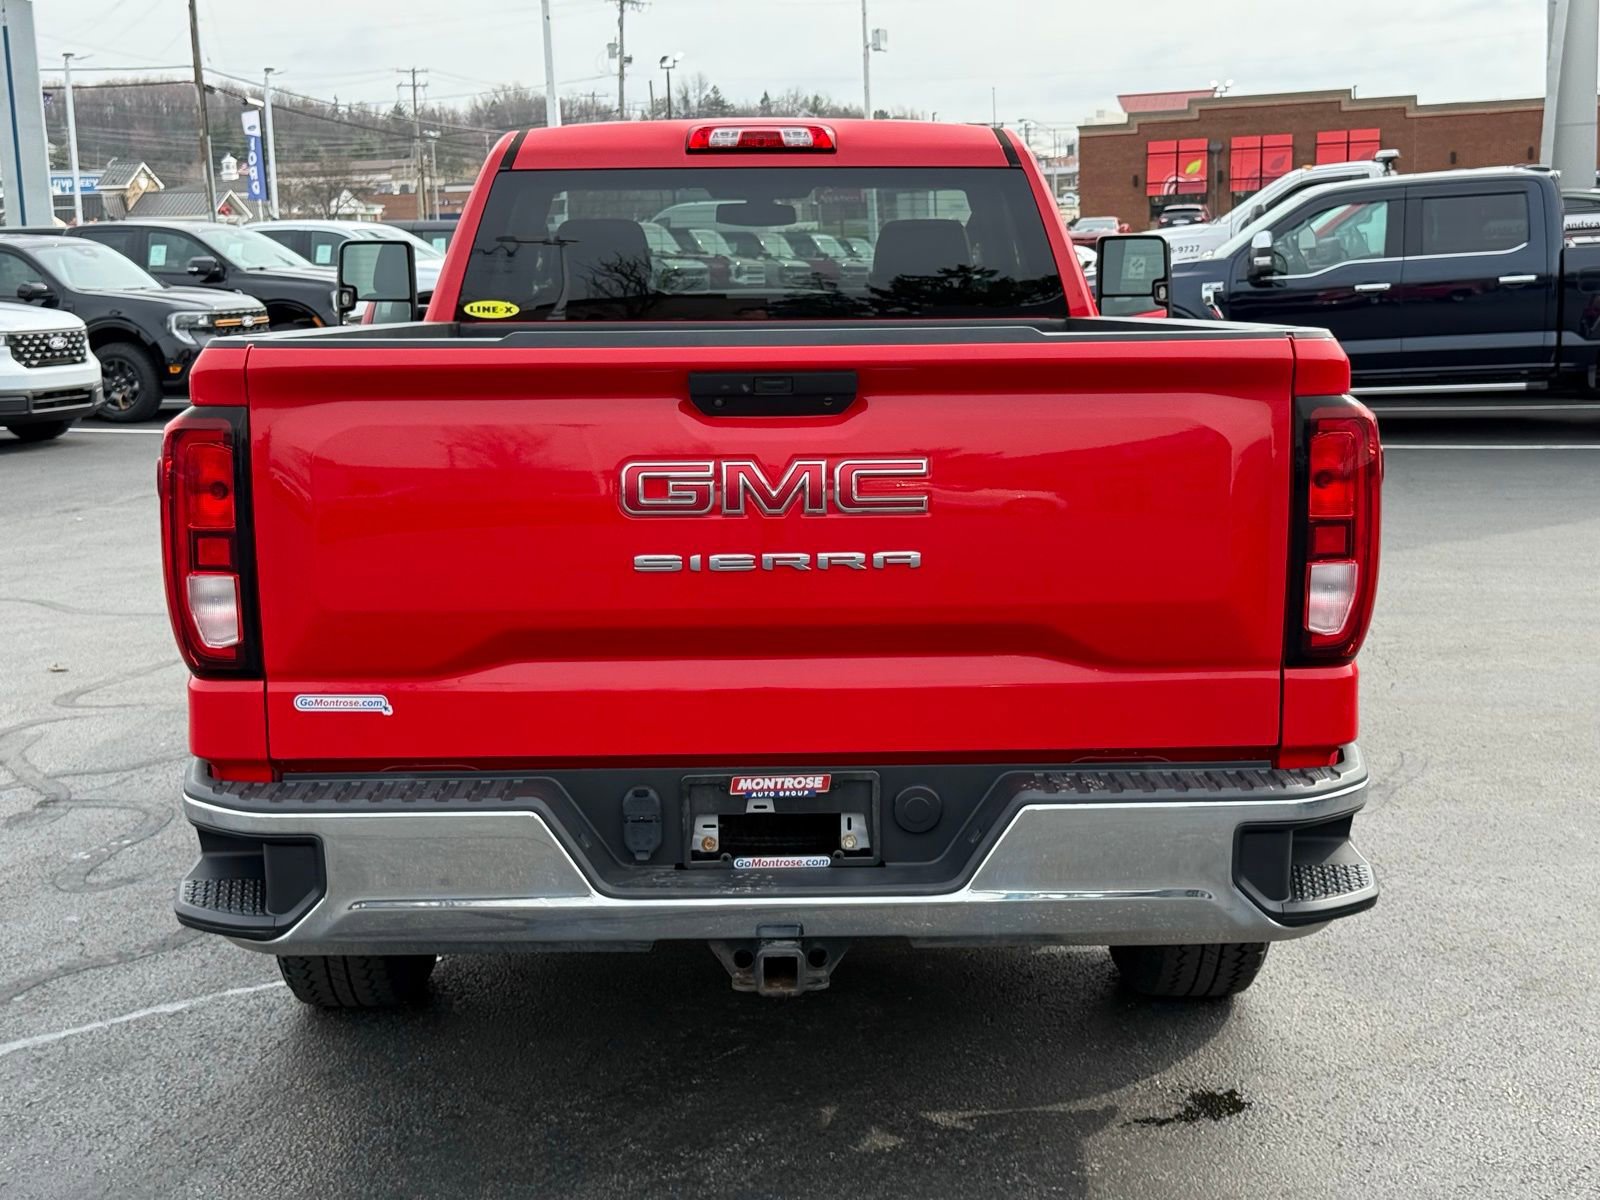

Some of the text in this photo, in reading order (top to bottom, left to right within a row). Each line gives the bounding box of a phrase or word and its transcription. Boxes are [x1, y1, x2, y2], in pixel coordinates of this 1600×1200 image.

[469, 305, 513, 314] LINE-X
[620, 458, 928, 516] GMC
[633, 551, 922, 572] SIERRA
[299, 698, 383, 708] GoMontrose.com
[737, 776, 824, 790] MONTROSE
[751, 789, 810, 798] AUTO GROUP
[735, 857, 829, 868] GoMontrose.com
